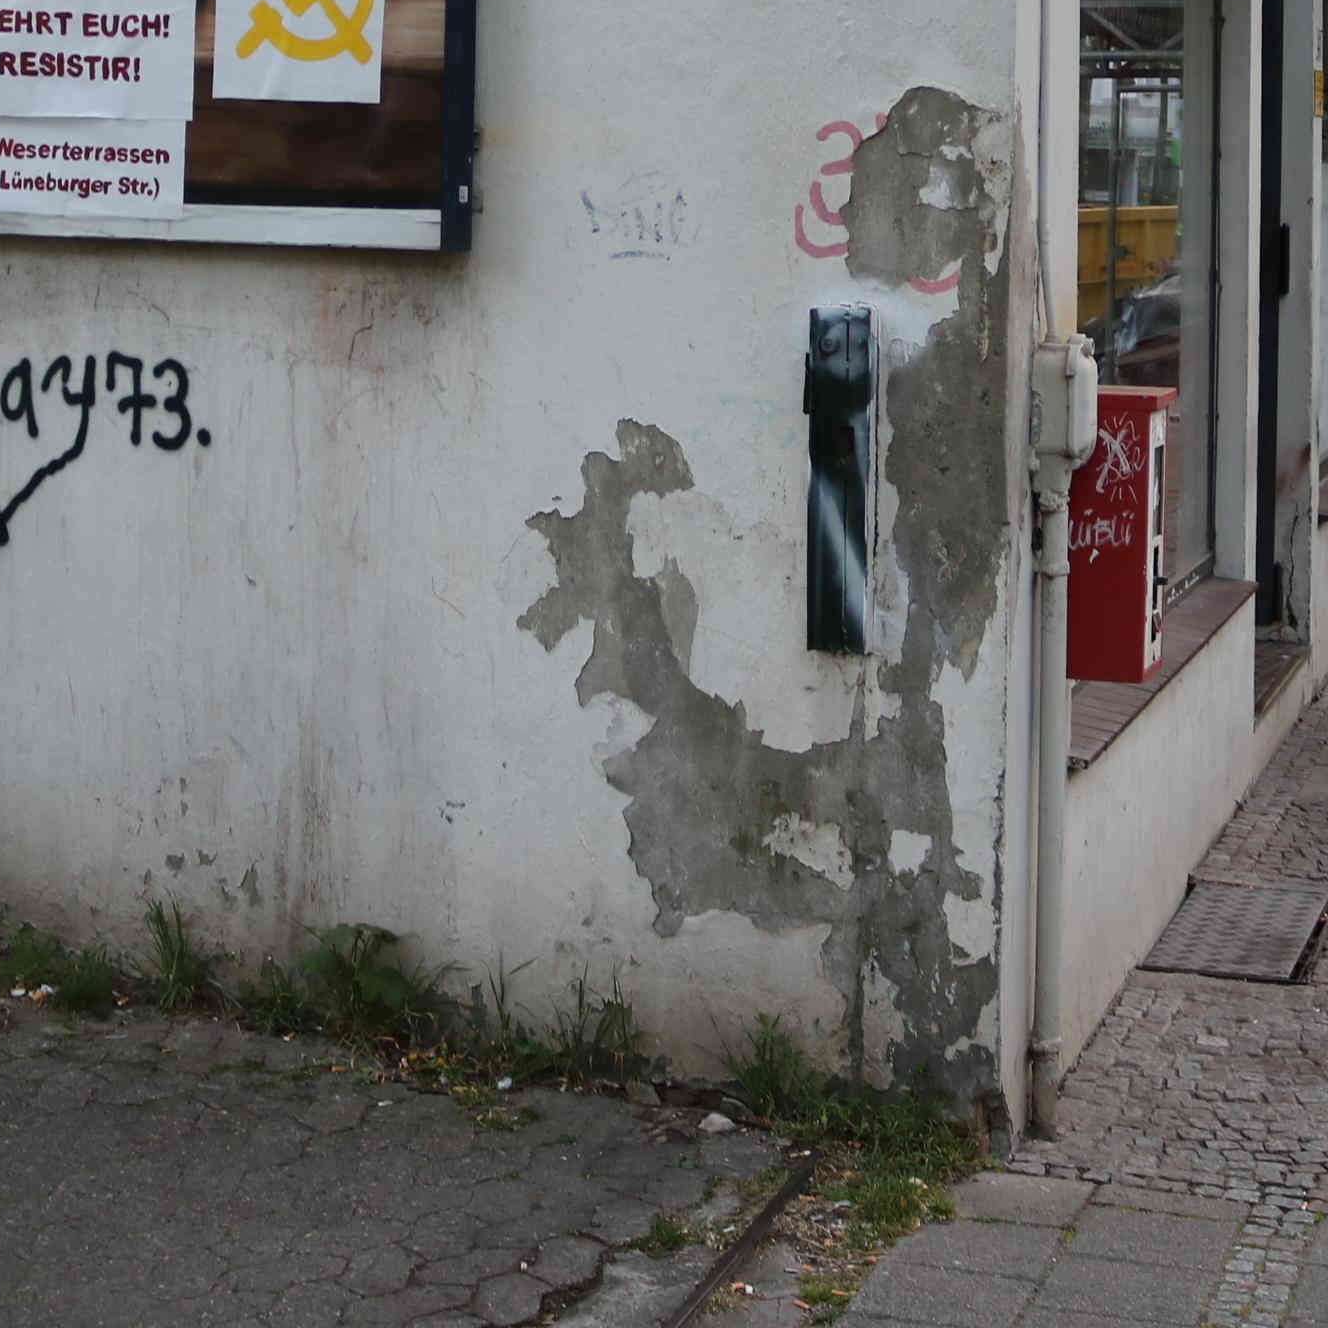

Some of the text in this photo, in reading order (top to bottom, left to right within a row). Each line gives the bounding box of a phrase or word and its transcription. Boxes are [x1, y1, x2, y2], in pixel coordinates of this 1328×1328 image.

[82, 12, 170, 38] EUCH!
[0, 169, 112, 198] Lüneburger
[118, 176, 160, 199] Str.)
